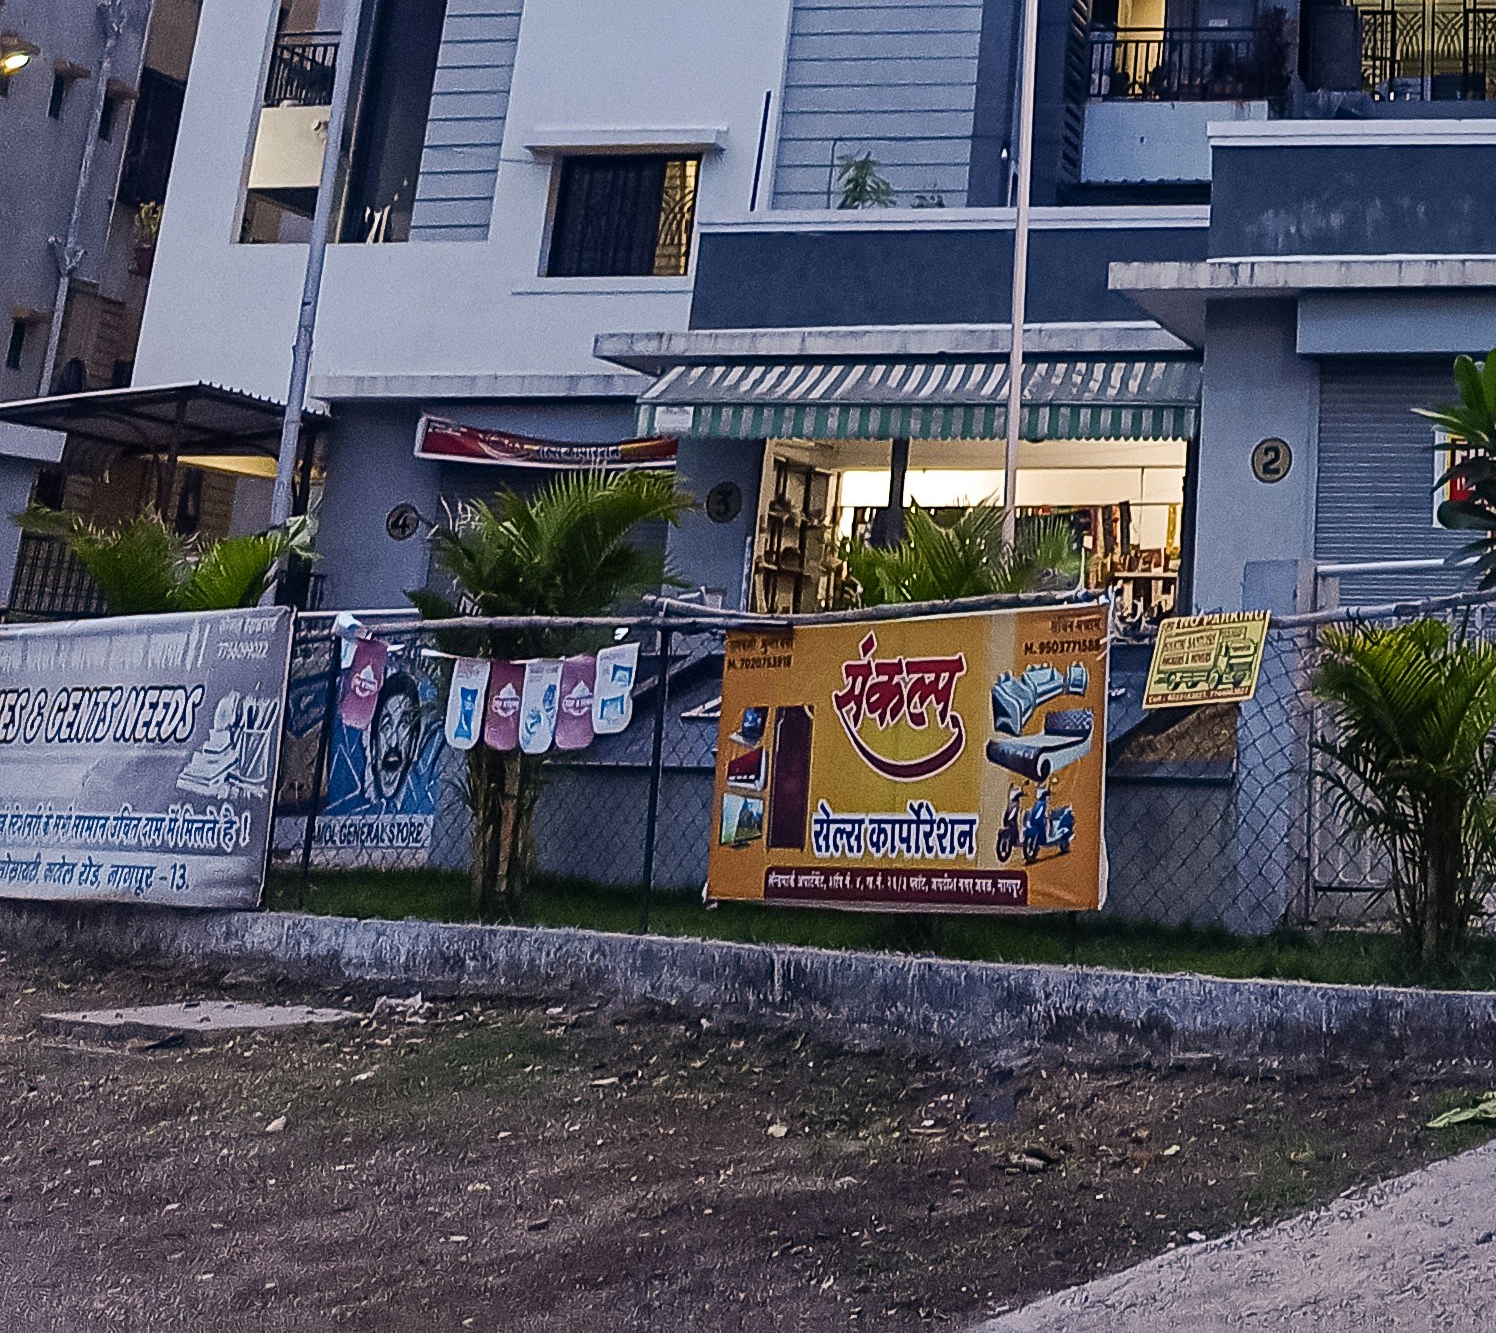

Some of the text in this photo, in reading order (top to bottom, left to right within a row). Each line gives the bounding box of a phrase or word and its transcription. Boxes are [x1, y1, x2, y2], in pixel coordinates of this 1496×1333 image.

[1262, 446, 1281, 475] 2
[391, 510, 411, 535] 4
[833, 630, 967, 731] संकल्प
[24, 686, 49, 744] &
[45, 685, 124, 743] GENTS
[113, 684, 206, 743] NEEDS
[339, 822, 387, 846] GENERAL
[388, 821, 424, 845] STORE
[812, 799, 980, 858] सेल्स कार्पोरेशन
